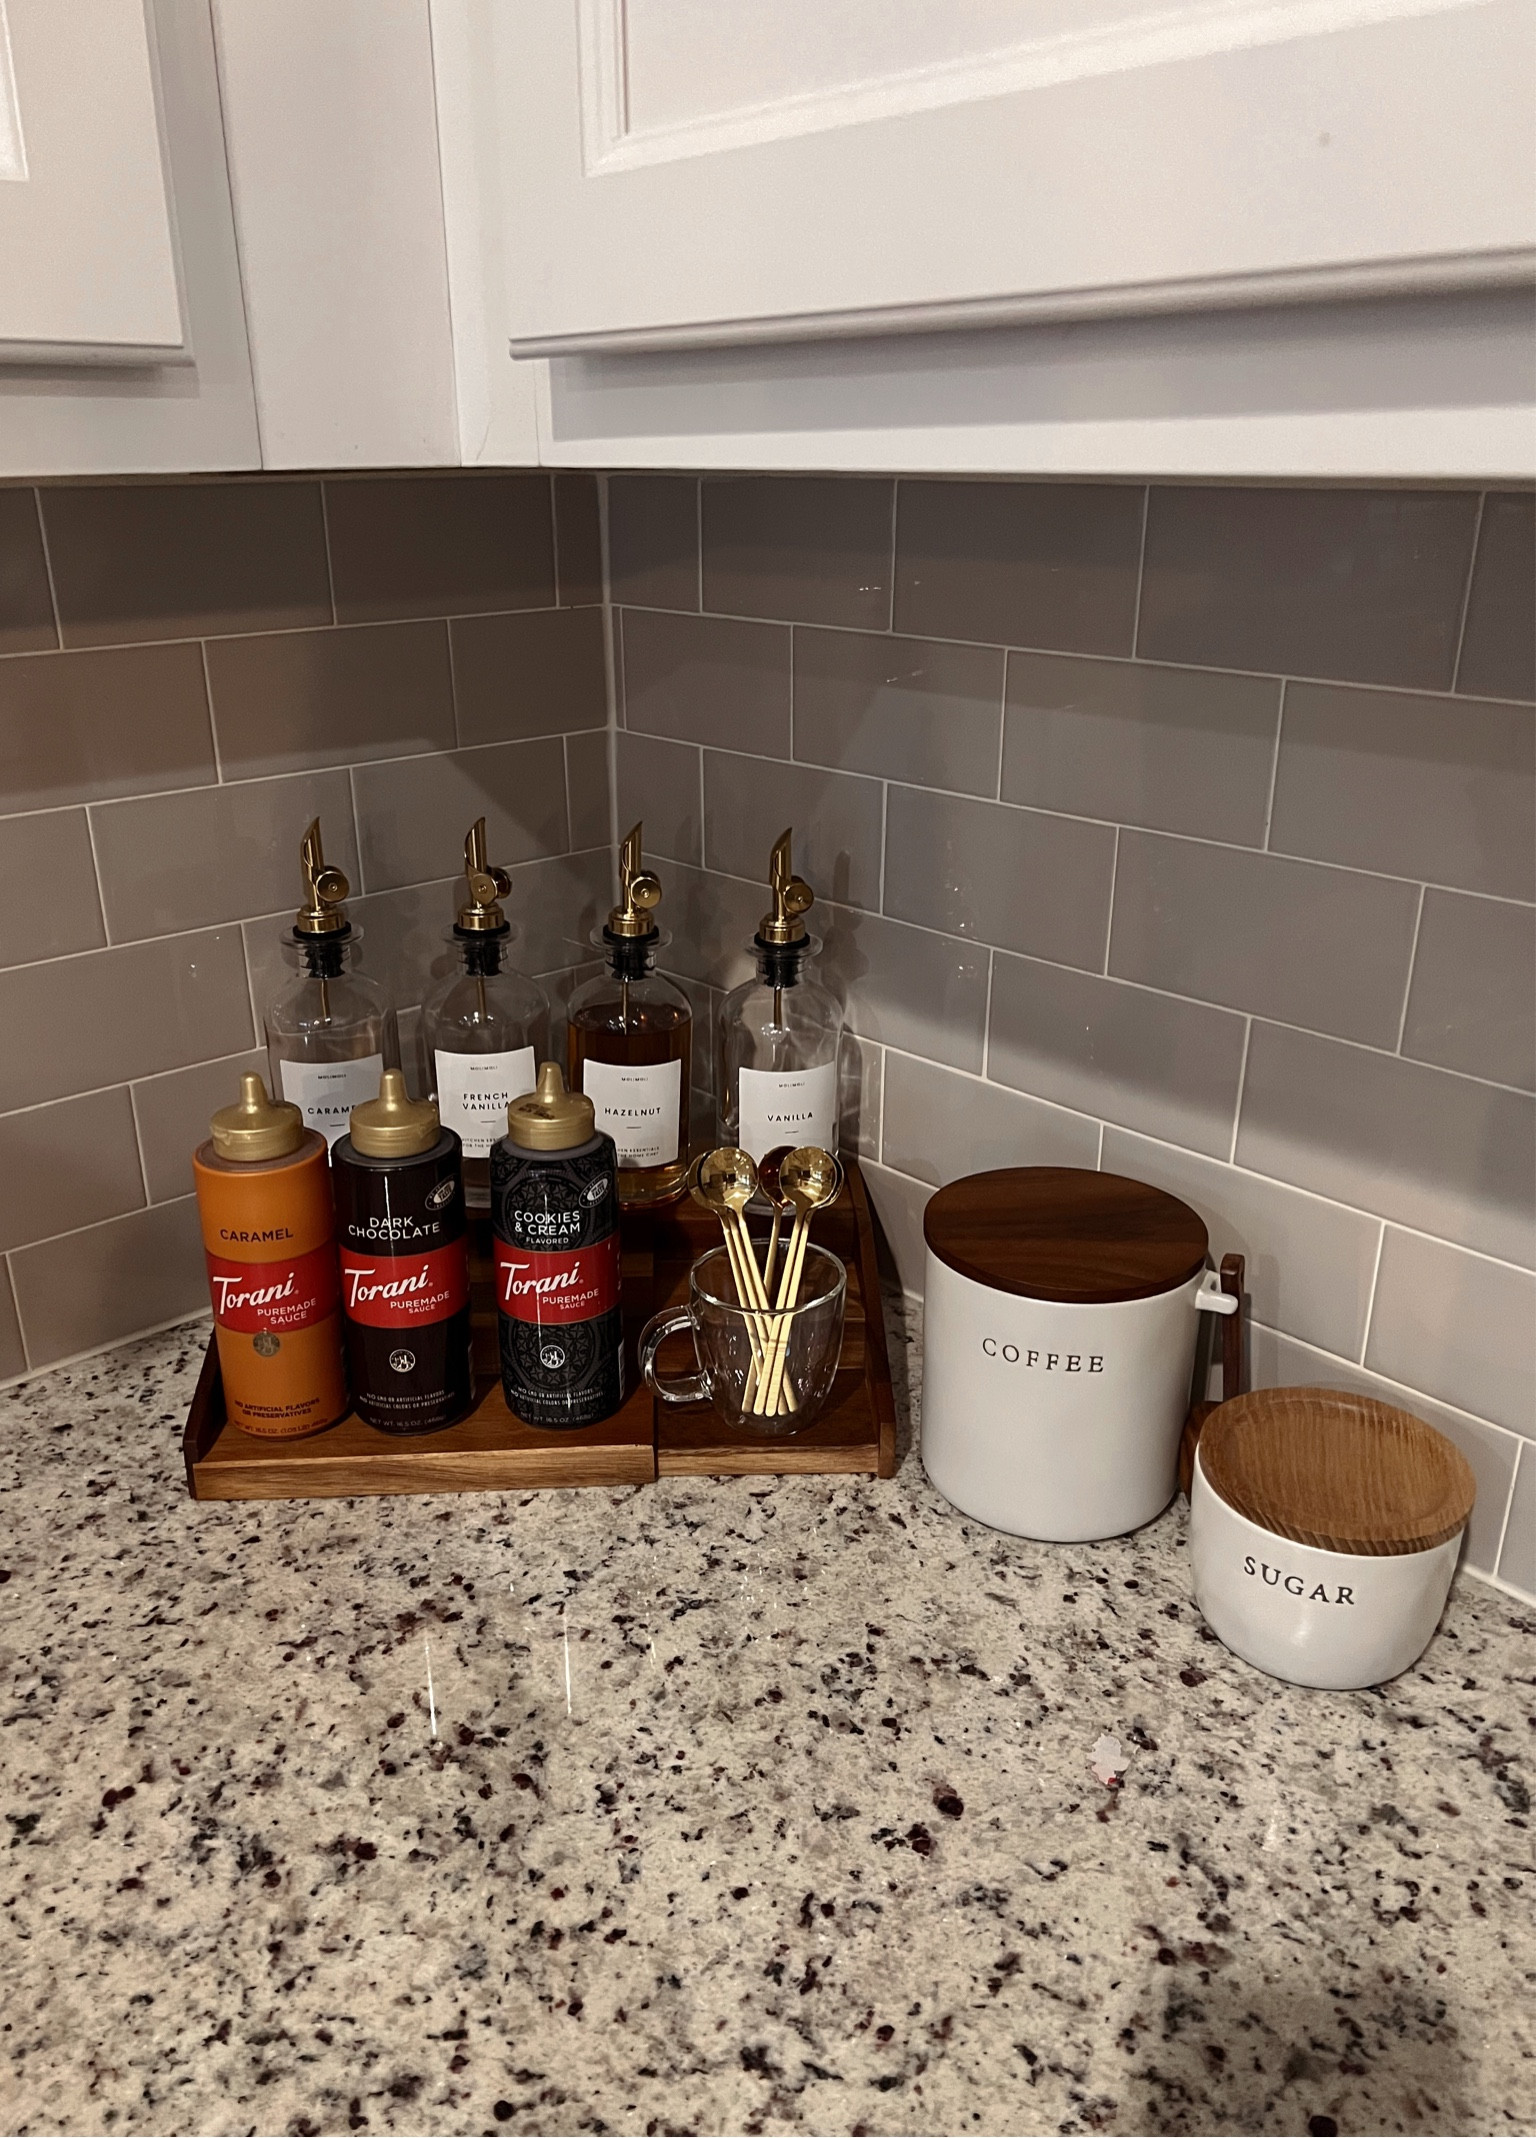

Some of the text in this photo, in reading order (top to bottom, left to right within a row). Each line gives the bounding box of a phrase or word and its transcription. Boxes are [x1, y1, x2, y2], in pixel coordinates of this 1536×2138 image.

[463, 1092, 508, 1100] FRENCH
[307, 1104, 356, 1114] CARAM
[604, 1106, 661, 1116] HAZELNUT
[767, 1112, 813, 1122] VANILLA
[369, 1216, 414, 1228] DARK
[514, 1210, 580, 1224] COOKIES
[220, 1228, 293, 1242] CARAMEL
[348, 1221, 440, 1240] CHOCOLATE
[515, 1222, 581, 1236] & CREAM
[526, 1236, 569, 1245] FLAVORED
[344, 1264, 430, 1308] Torani
[500, 1261, 581, 1301] Torani
[213, 1272, 296, 1315] Torani
[390, 1290, 450, 1309] PUREMADE
[542, 1288, 599, 1305] PUREMADE
[257, 1298, 316, 1317] PUREMADE
[408, 1304, 436, 1314] SAUCE
[559, 1301, 586, 1310] SAUCE
[270, 1311, 307, 1325] SAUCE
[982, 1336, 1105, 1374] COFFEE
[245, 1404, 283, 1412] ARTIFICIAL
[253, 1408, 312, 1418] PRESERVATIVES
[1243, 1555, 1355, 1606] SUGAR
